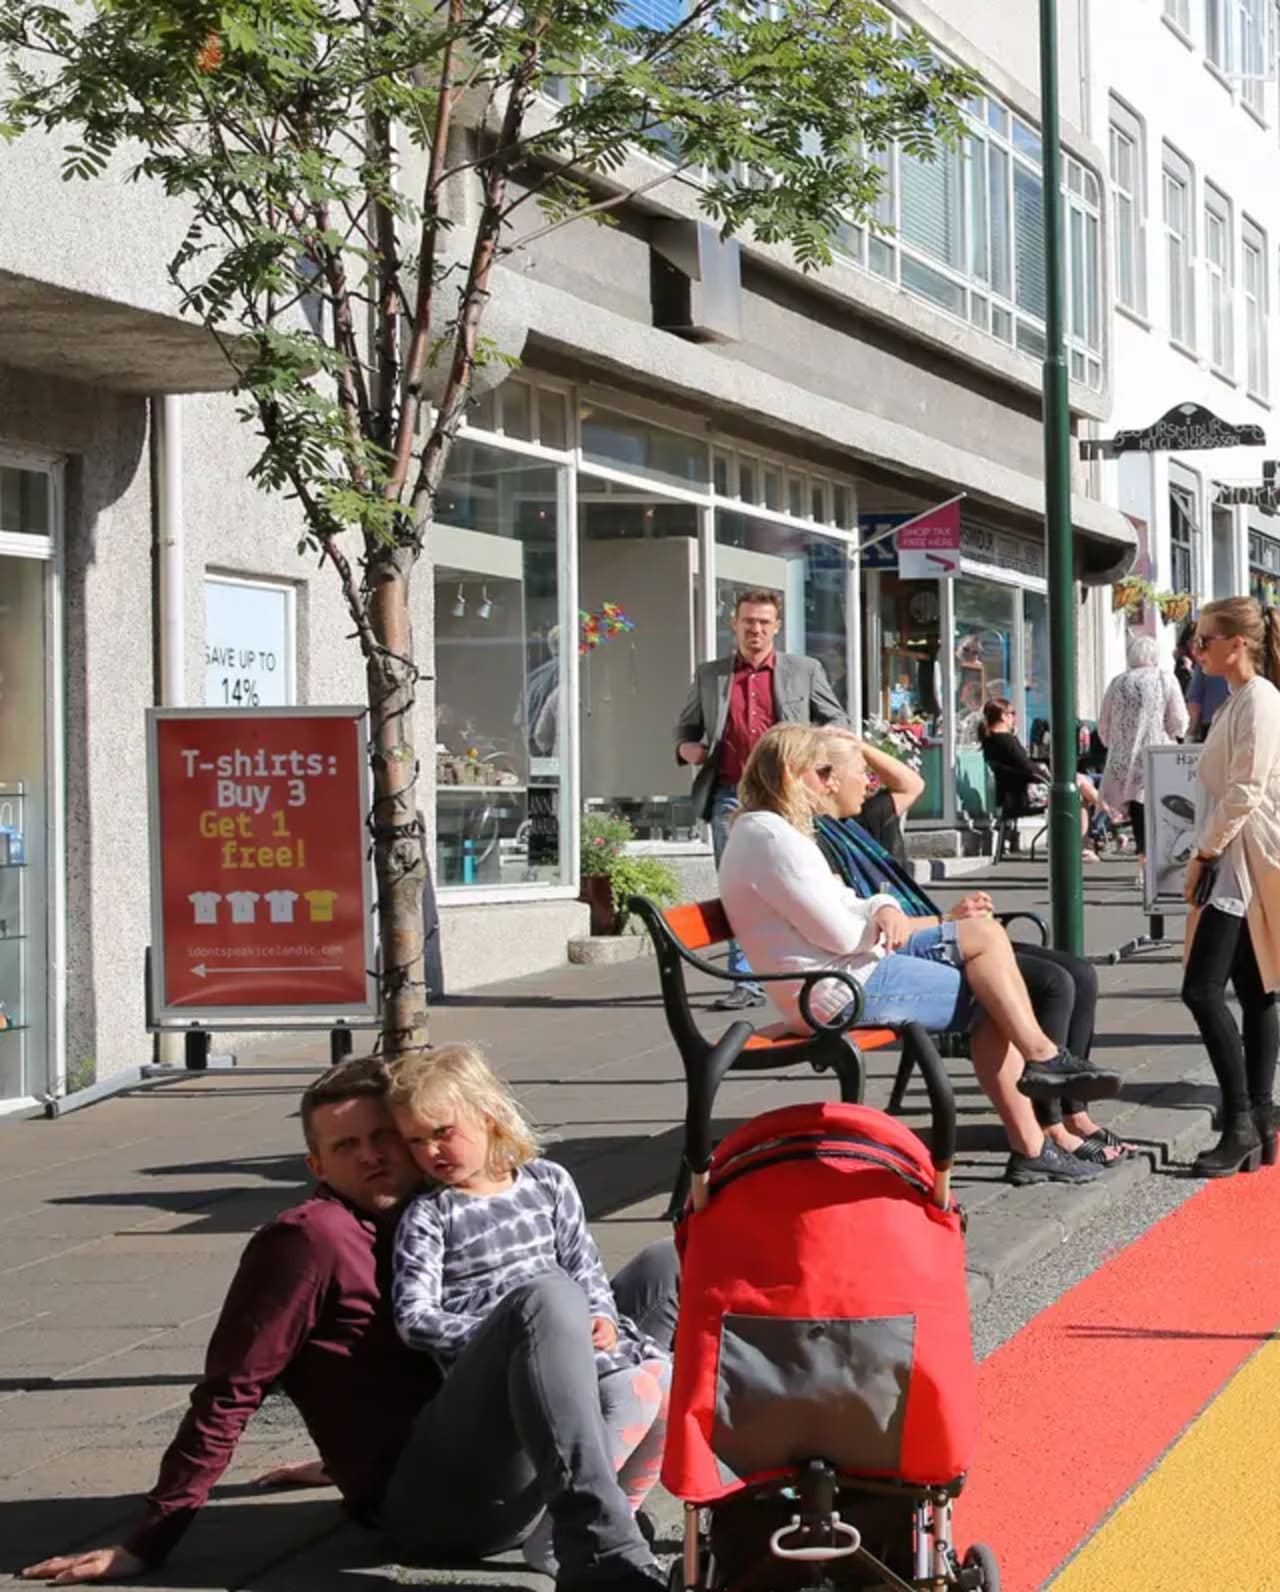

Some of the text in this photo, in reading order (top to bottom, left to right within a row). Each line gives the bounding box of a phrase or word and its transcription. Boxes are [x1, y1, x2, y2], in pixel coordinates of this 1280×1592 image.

[902, 527, 951, 537] SHOP TAX
[902, 537, 953, 547] FREE HERE
[239, 650, 256, 669] UP
[259, 651, 276, 672] TO
[221, 677, 260, 707] 14%
[181, 748, 338, 778] T-shirts:
[217, 779, 307, 814] Buy 3
[200, 810, 291, 838] Get 1
[221, 838, 306, 869] free!
